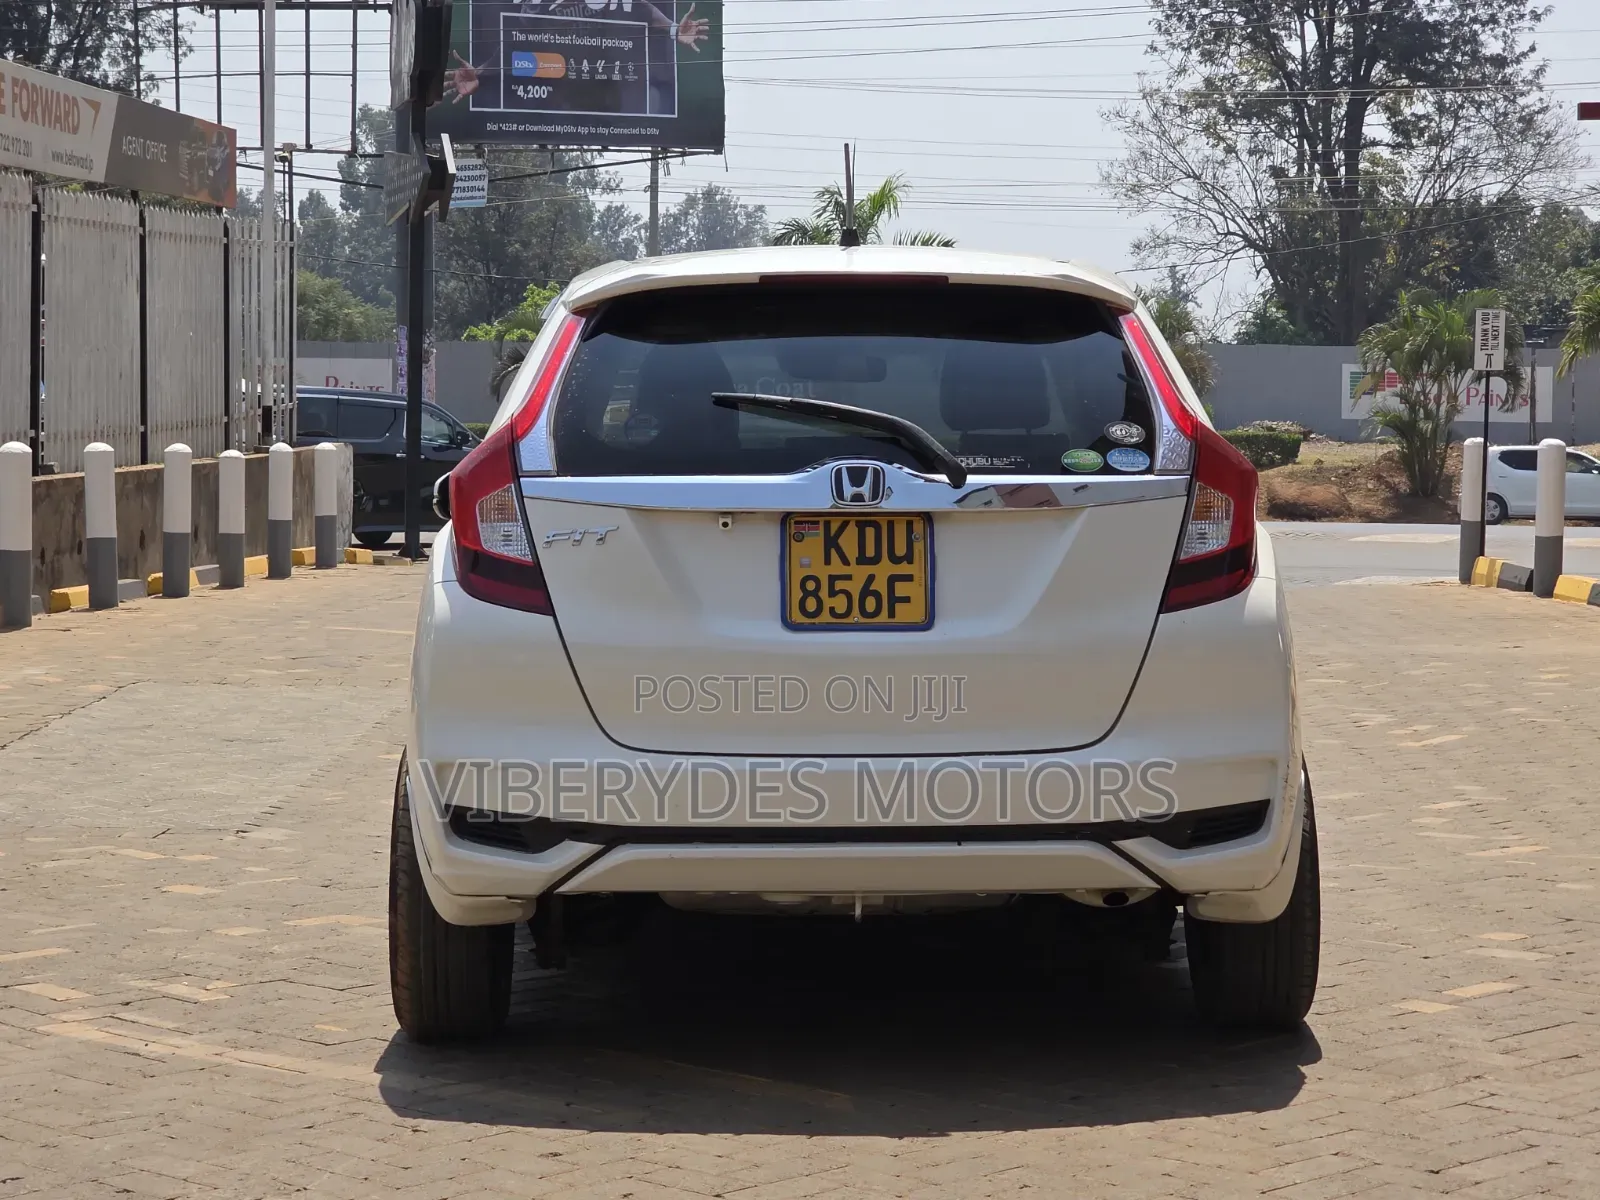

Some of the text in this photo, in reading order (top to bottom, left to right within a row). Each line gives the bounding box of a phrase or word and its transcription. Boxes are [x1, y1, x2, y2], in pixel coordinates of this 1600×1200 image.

[512, 31, 633, 50] The world's best football package
[11, 76, 81, 136] FORWARD
[517, 84, 548, 99] 4,200
[486, 122, 498, 131] Dial
[525, 124, 555, 132] Download
[556, 124, 577, 134] MyDStv
[577, 126, 589, 135] App
[596, 126, 609, 136] stay
[609, 127, 640, 135] Connected
[640, 127, 647, 135] to
[647, 127, 660, 136] DStv
[122, 135, 167, 163] AGENT OFFICE
[1480, 312, 1490, 351] THANK YOU
[1490, 311, 1500, 351] TILL NEXT TIME
[542, 525, 619, 549] FIT
[823, 519, 914, 567] KDU
[798, 573, 914, 620] 856F
